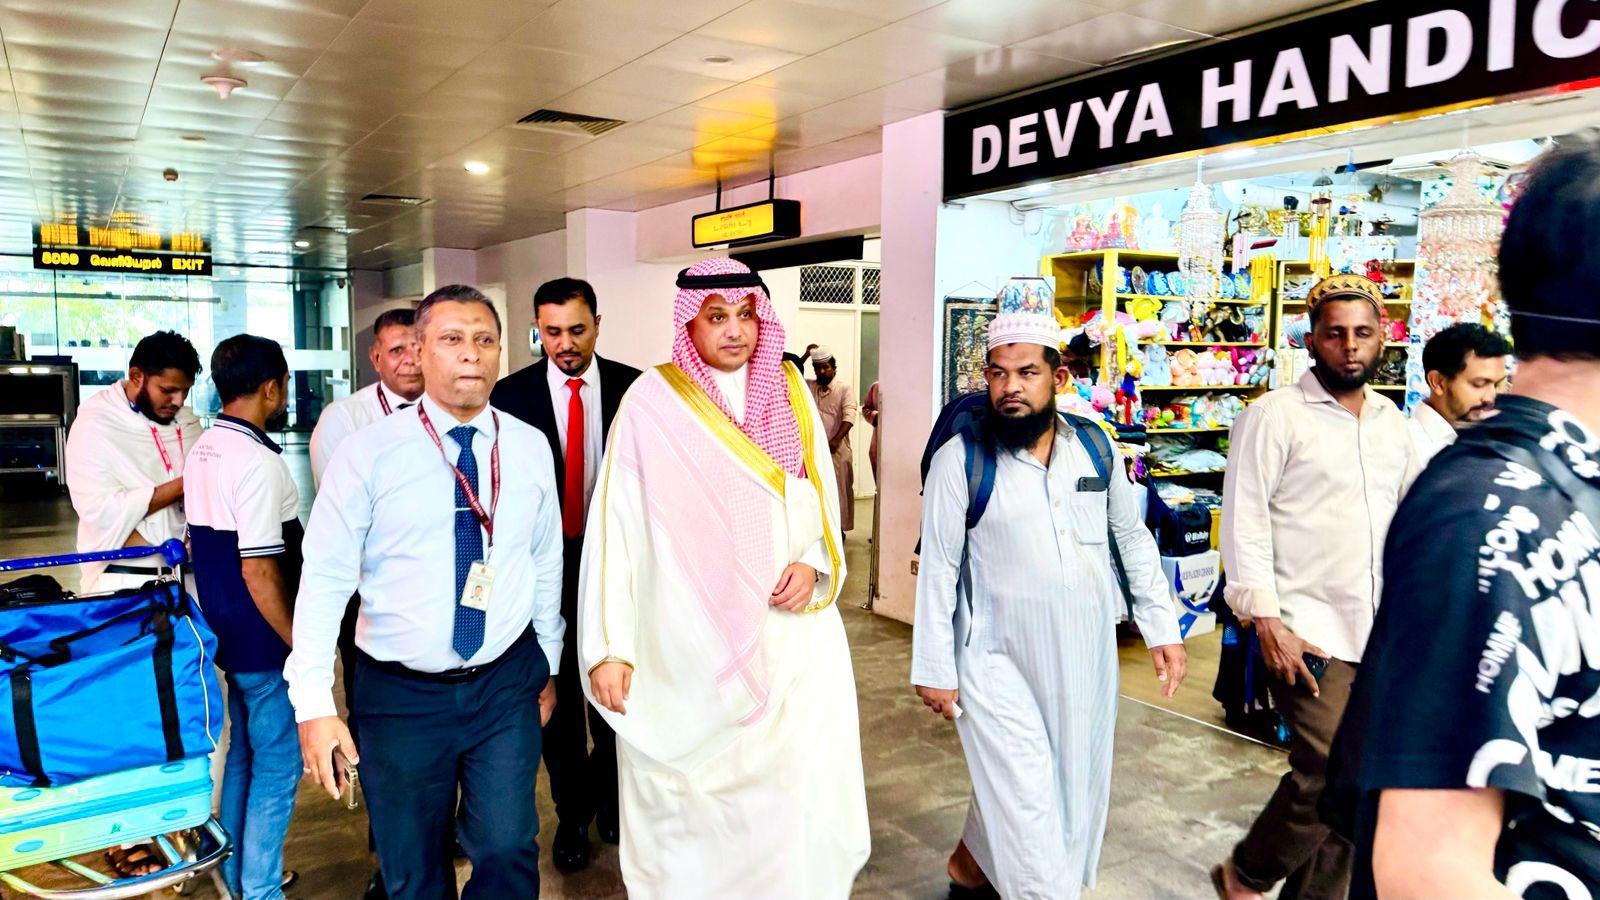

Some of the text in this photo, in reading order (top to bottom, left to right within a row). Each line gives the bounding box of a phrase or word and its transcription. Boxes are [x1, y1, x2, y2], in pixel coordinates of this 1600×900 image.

[971, 0, 1600, 175] DEVYA HANDIC
[172, 258, 205, 270] EXIT
